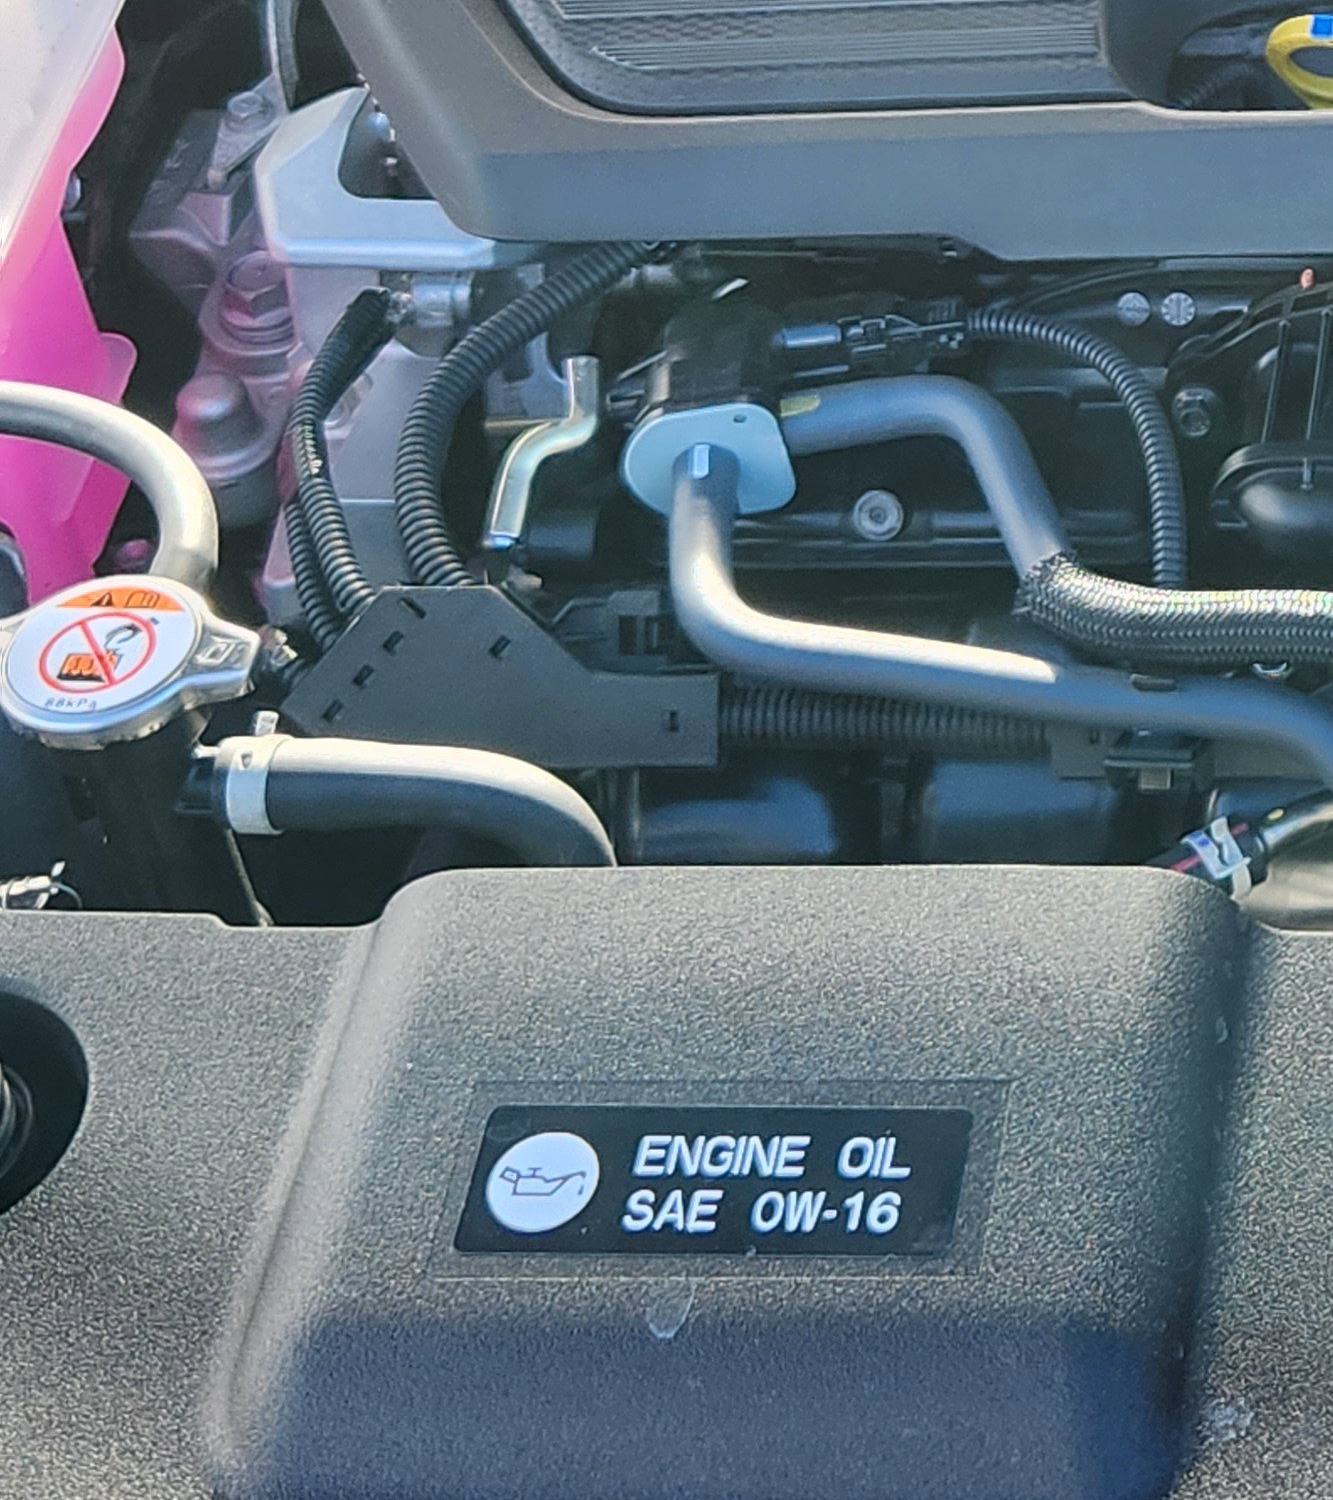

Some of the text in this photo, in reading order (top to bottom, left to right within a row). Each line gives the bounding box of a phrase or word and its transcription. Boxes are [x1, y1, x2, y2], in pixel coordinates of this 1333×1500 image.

[633, 1134, 911, 1178] ENGINE OIL
[621, 1189, 901, 1234] SAE 0W-16
